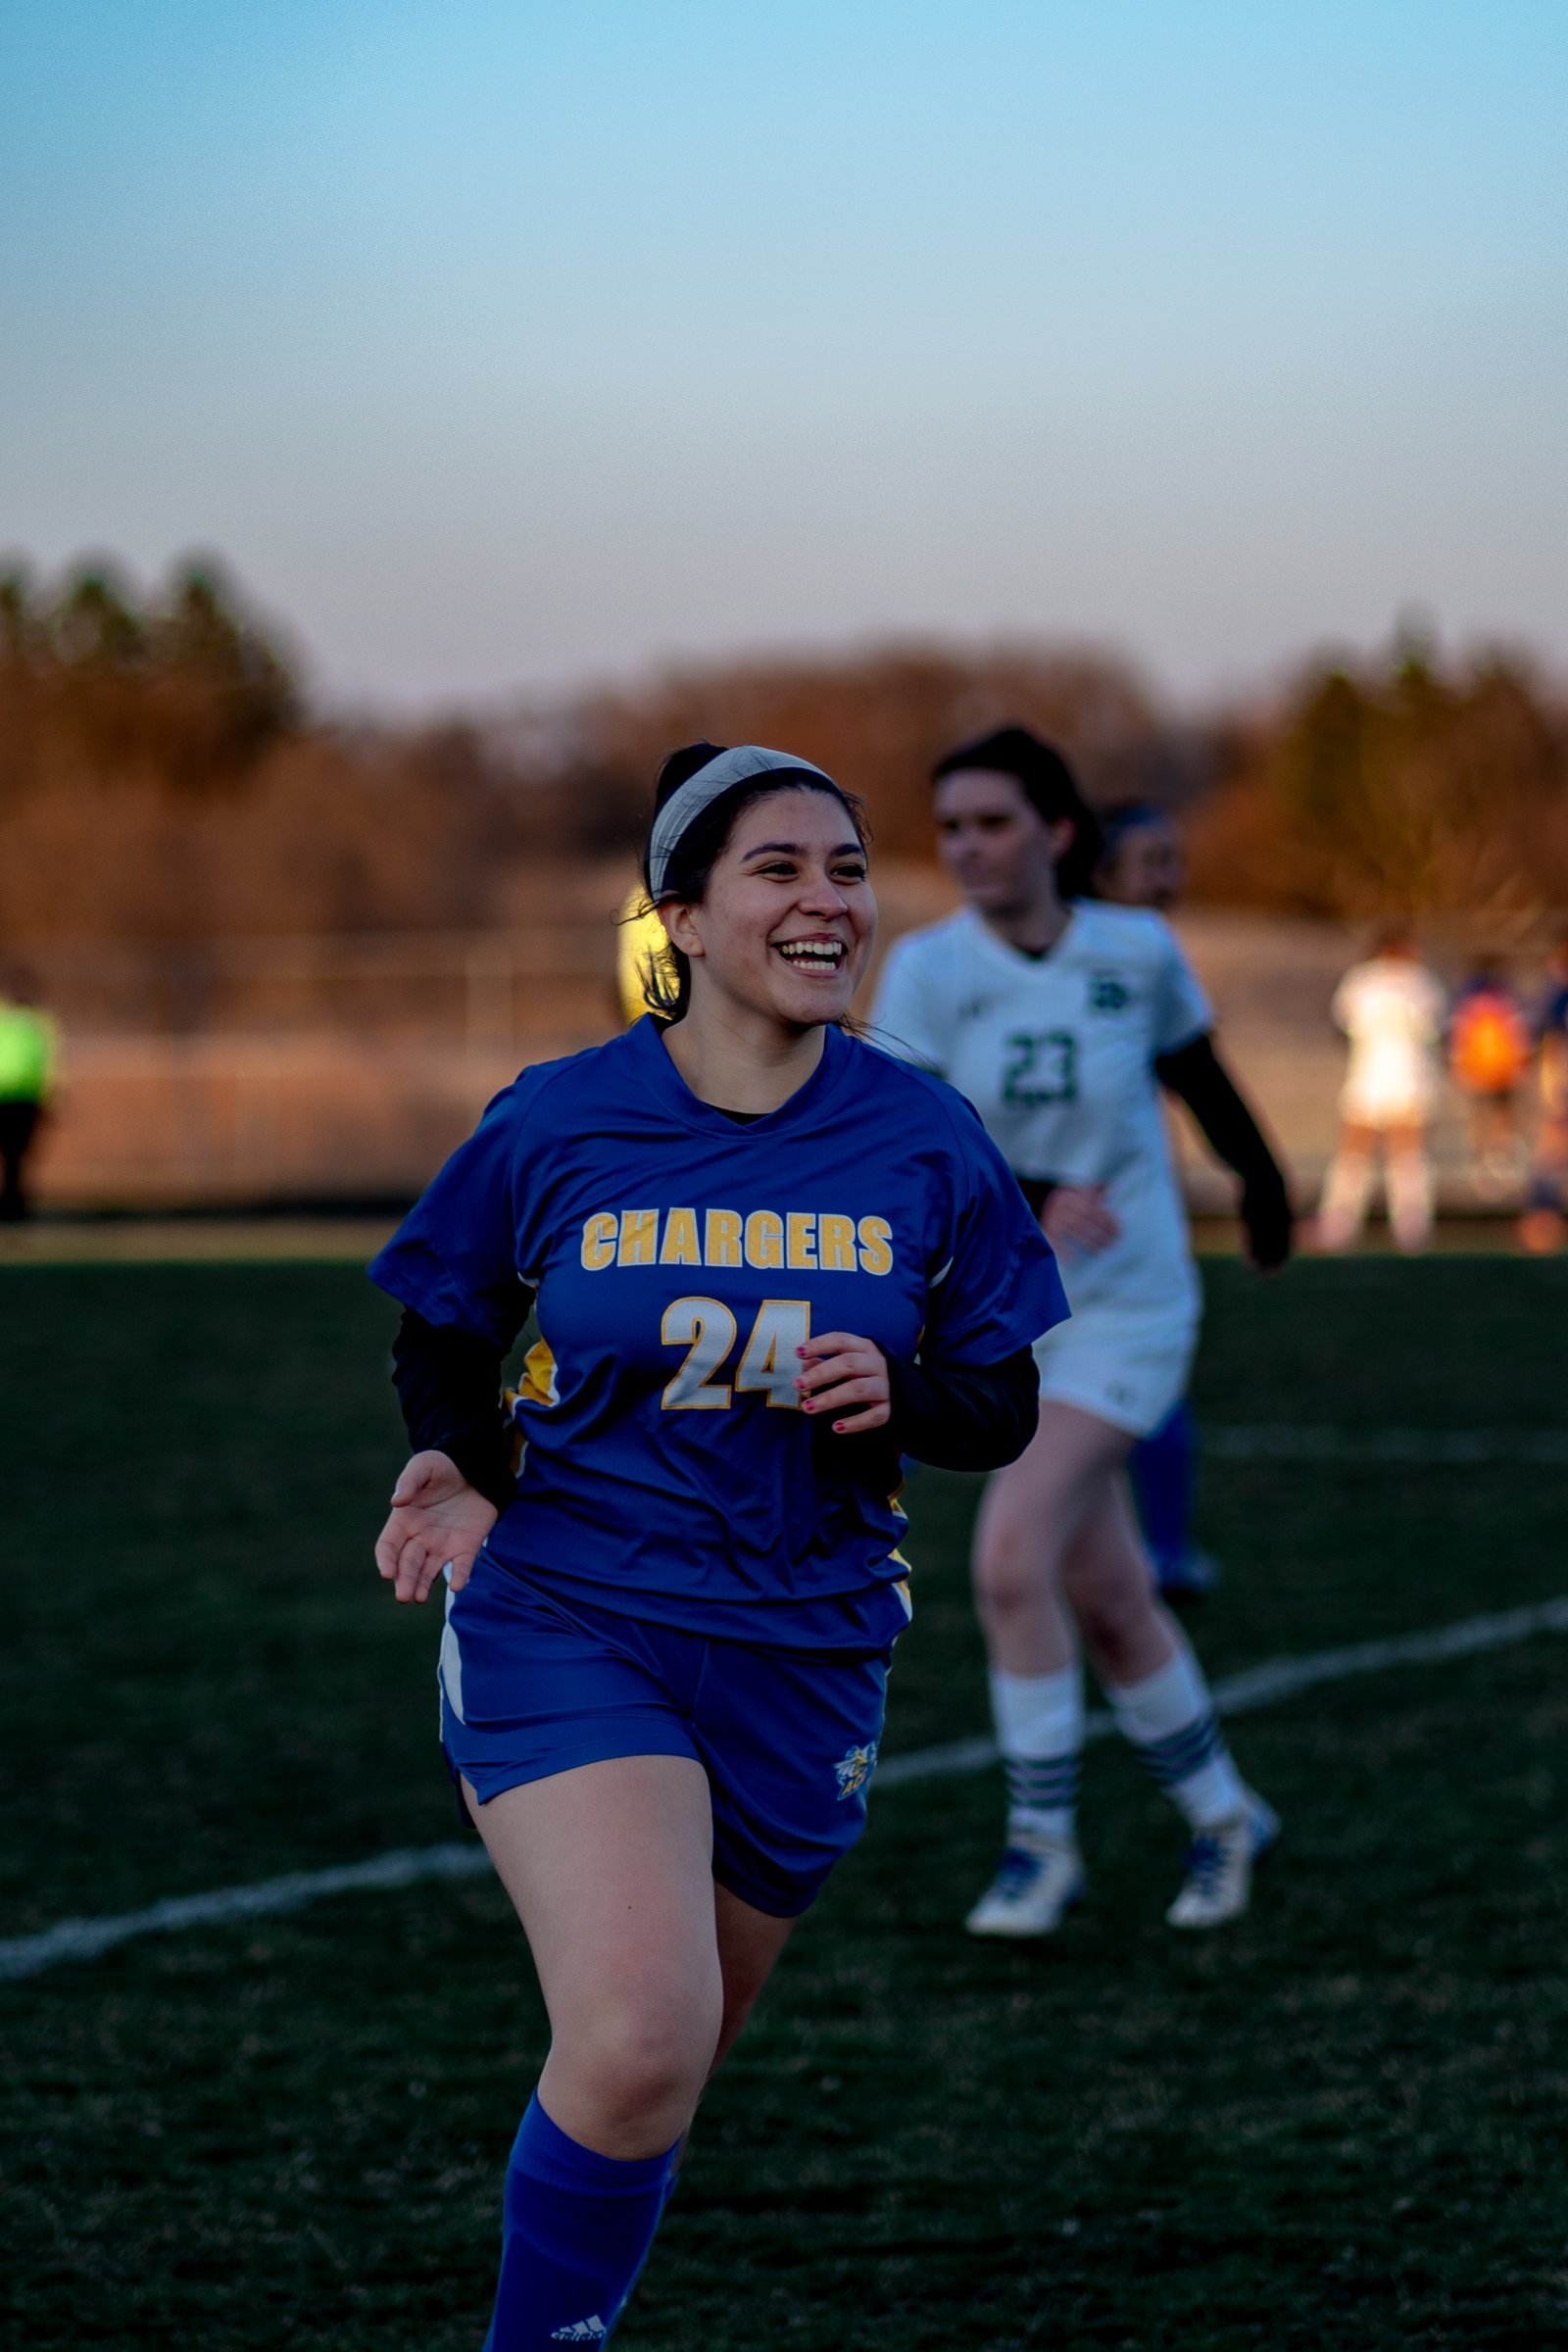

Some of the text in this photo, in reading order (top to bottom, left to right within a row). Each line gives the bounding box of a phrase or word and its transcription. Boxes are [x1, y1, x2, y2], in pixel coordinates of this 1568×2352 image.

[1004, 1033, 1075, 1102] 23
[581, 1207, 894, 1276] CHARGERS
[662, 1297, 810, 1411] 24
